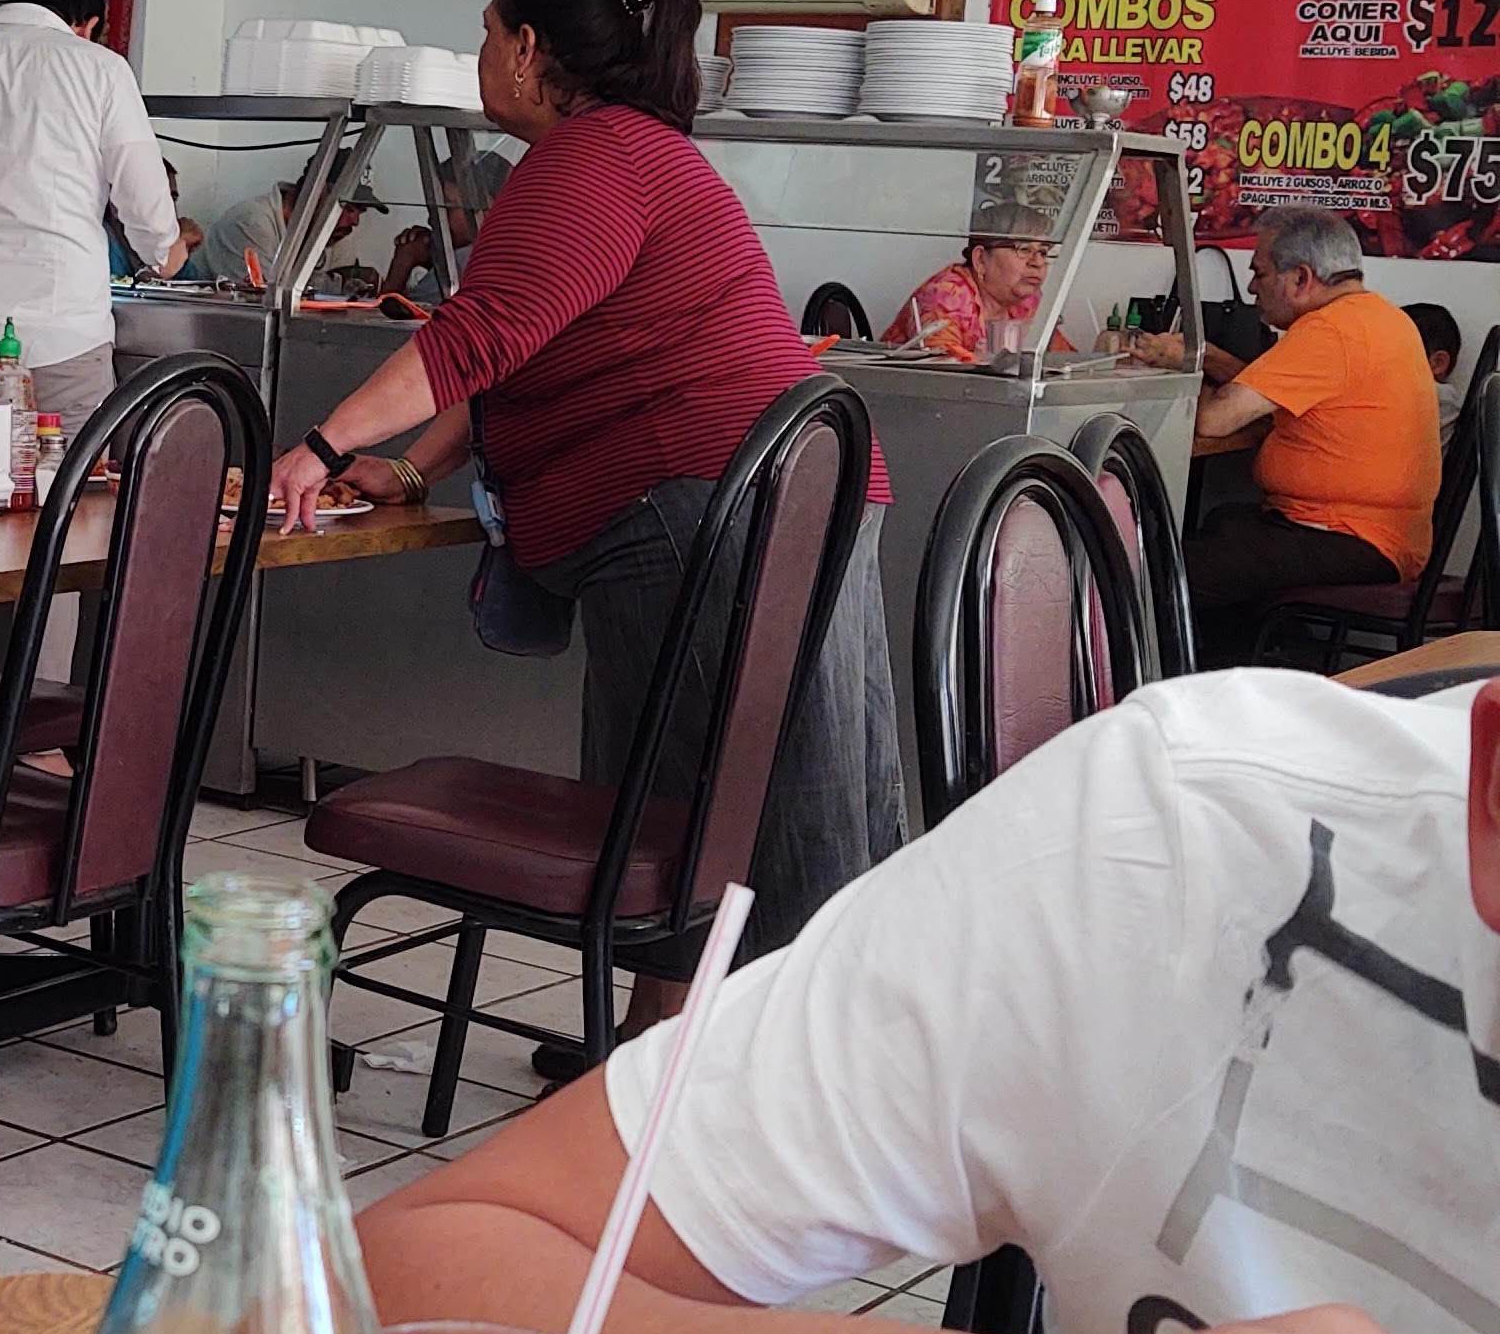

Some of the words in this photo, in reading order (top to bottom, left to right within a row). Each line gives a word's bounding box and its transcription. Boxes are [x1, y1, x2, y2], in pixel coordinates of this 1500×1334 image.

[1299, 2, 1399, 21] COMER
[1311, 24, 1382, 43] AQUI
[1092, 37, 1204, 64] LLEVAR
[1301, 46, 1351, 56] INCLUYE
[1354, 47, 1398, 57] BEBIDA
[1057, 74, 1100, 85] INCLUYE
[1168, 71, 1214, 104] $48
[1163, 119, 1208, 149] $58
[1237, 119, 1362, 171] COMBO
[1368, 123, 1392, 171] 4
[984, 156, 1003, 185] 2
[1404, 130, 1500, 205] $75
[1241, 175, 1283, 187] INCLUYE
[1286, 177, 1292, 187] 2
[1338, 178, 1373, 190] ARROZ
[1375, 180, 1382, 191] O
[1241, 193, 1290, 205] SPAGUETTI
[1352, 197, 1368, 207] 500
